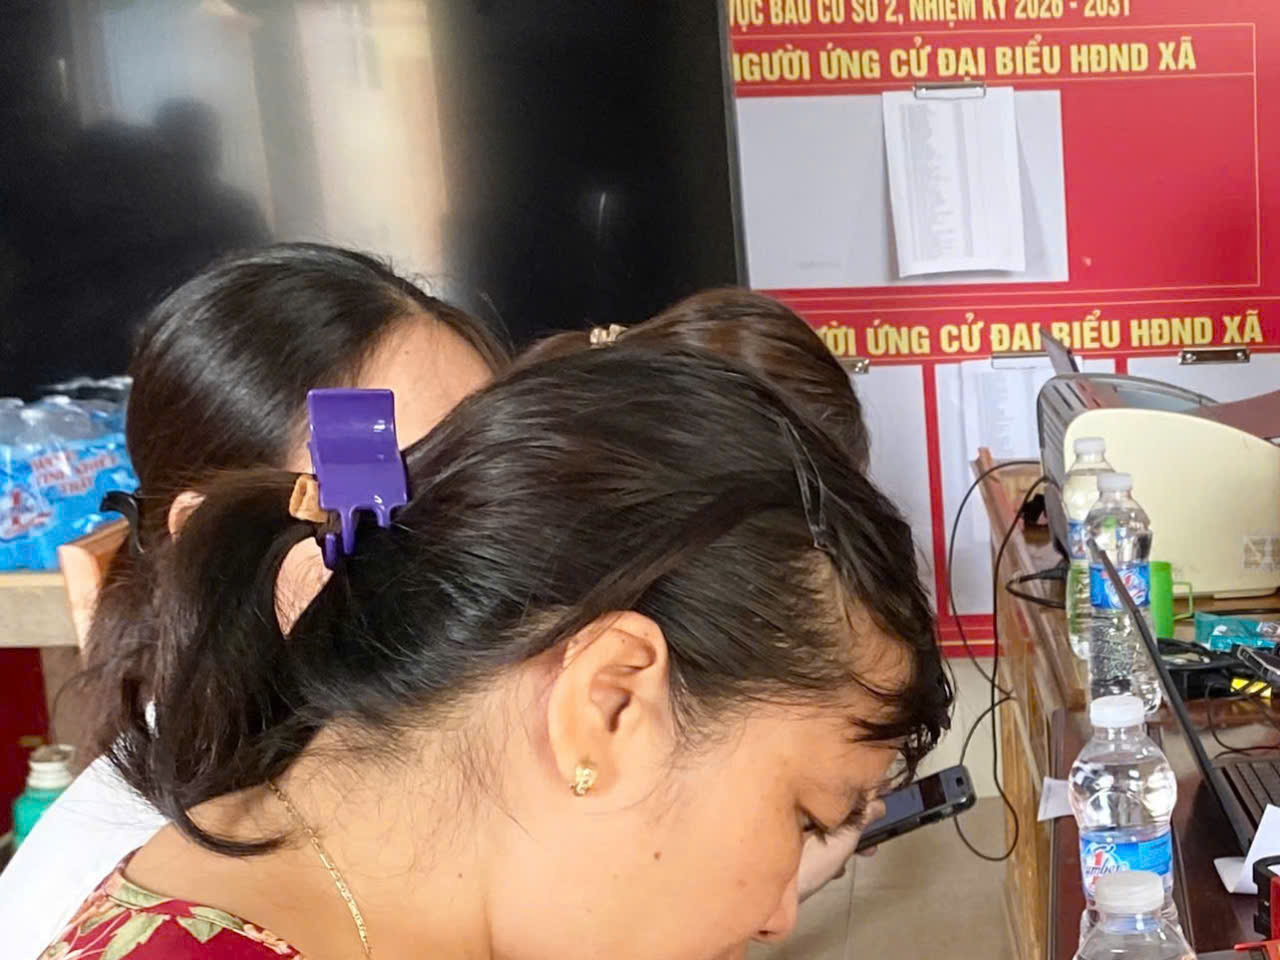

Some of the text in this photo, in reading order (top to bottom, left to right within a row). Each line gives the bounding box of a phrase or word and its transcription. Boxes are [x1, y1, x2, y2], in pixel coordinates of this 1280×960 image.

[819, 42, 881, 80] ỨNG
[890, 36, 931, 78] CỬ
[937, 47, 986, 81] ĐẠI
[995, 34, 1061, 76] BIỂU
[1070, 43, 1149, 74] HĐND
[1158, 36, 1197, 71] XÃ
[866, 318, 930, 355] ỨNG
[940, 312, 984, 353] CỬ
[1051, 309, 1121, 348] BIỂU
[1130, 316, 1213, 347] HĐND
[1223, 309, 1263, 343] XÃ
